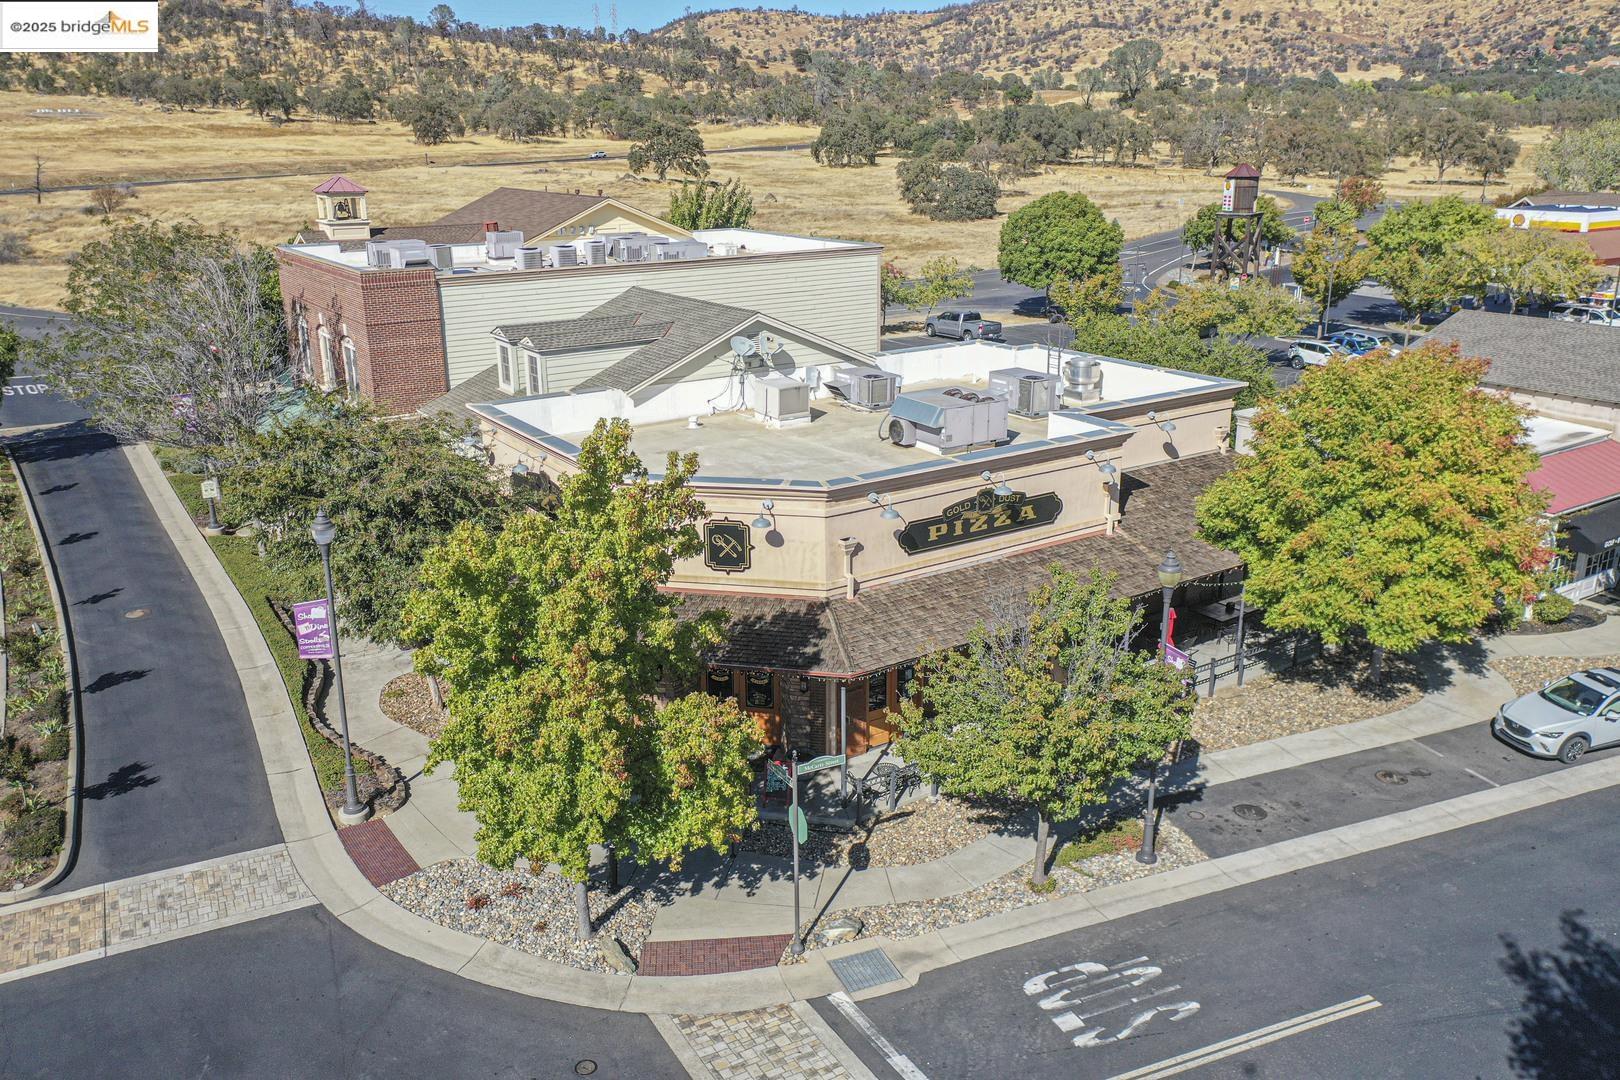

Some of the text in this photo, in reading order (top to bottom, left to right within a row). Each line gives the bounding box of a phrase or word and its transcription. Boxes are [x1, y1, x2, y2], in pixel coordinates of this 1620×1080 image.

[1, 383, 48, 396] STOP
[946, 493, 1021, 517] GOLD DUST
[928, 504, 1037, 542] PIZZA
